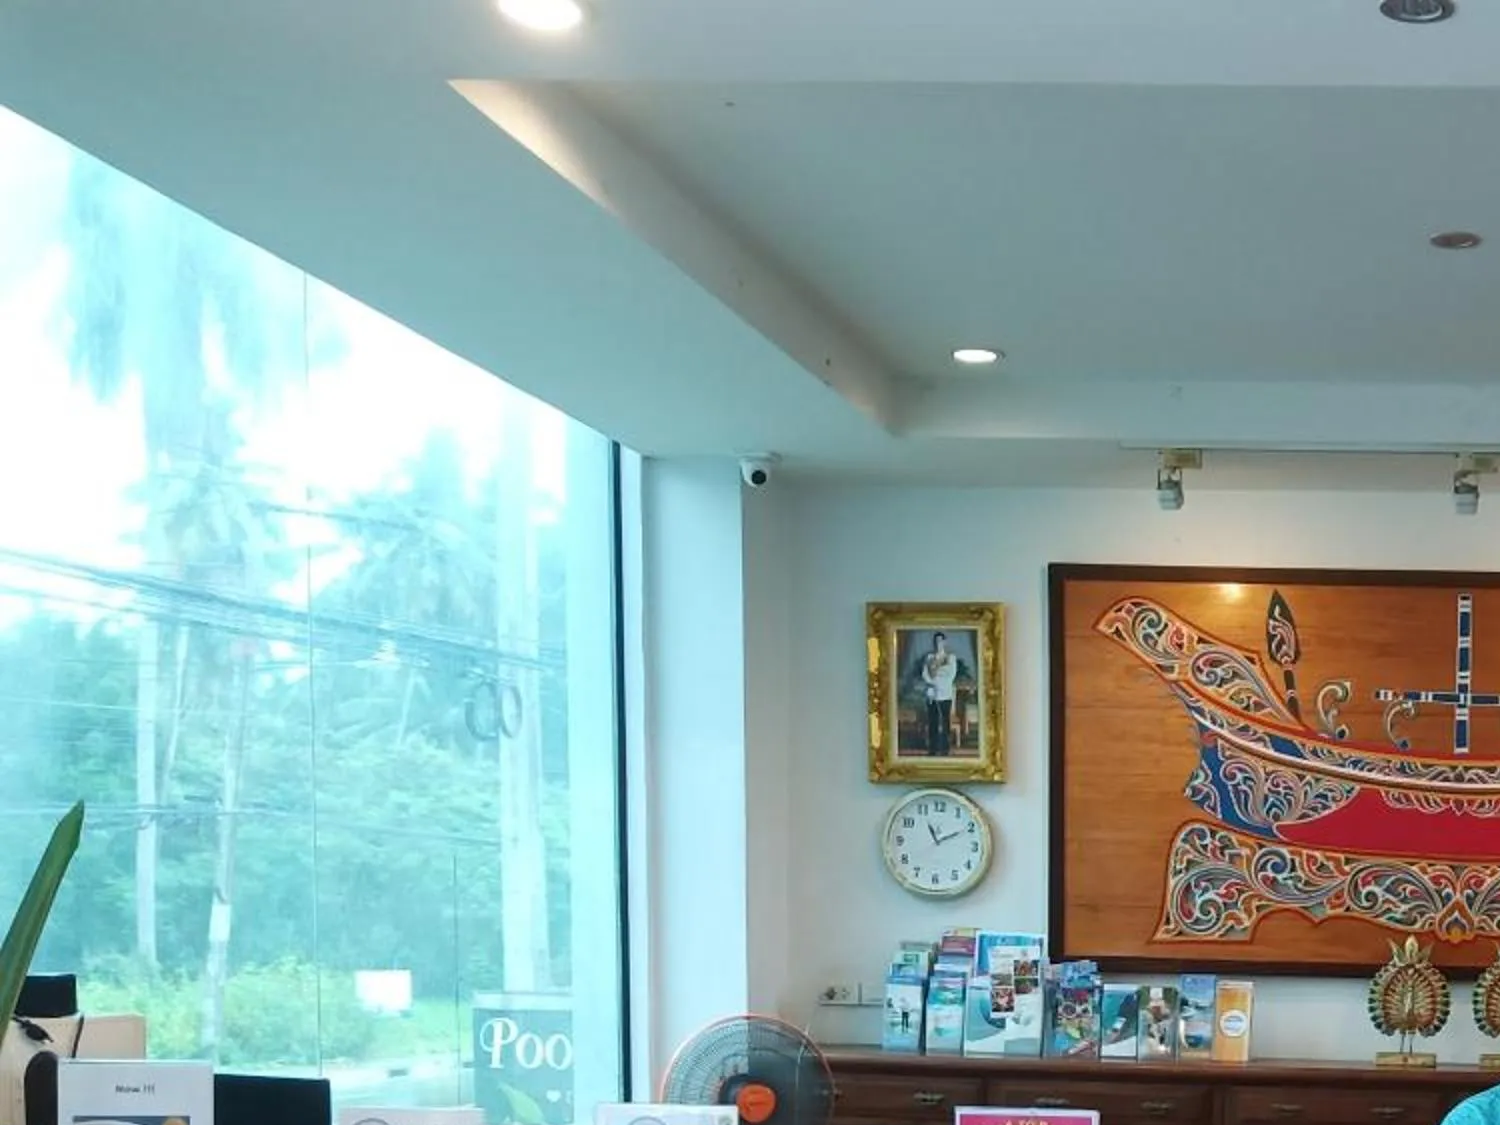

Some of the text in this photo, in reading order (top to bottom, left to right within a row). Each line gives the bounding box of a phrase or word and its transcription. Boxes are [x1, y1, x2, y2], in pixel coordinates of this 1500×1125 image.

[918, 804, 929, 816] 11
[934, 801, 946, 812] 12
[955, 807, 961, 818] 1
[903, 818, 915, 828] 10
[967, 822, 975, 833] 2
[971, 841, 979, 853] 3
[963, 860, 971, 870] 4
[913, 867, 921, 878] 7
[951, 870, 959, 881] 5
